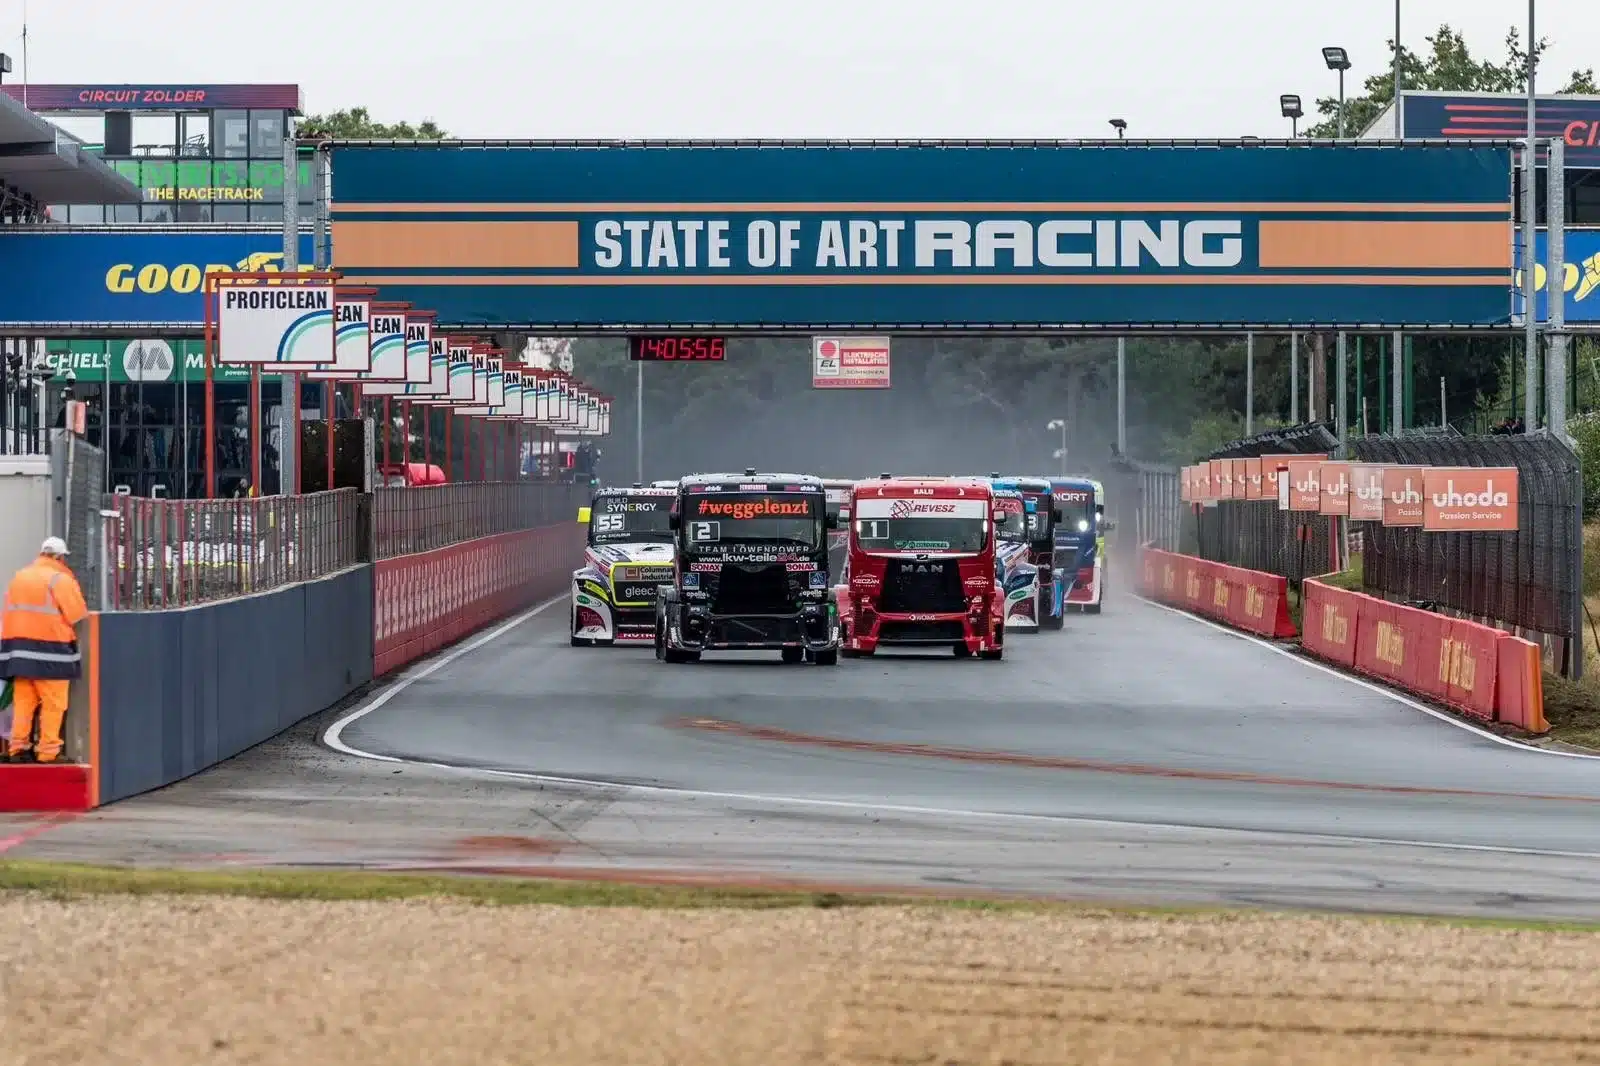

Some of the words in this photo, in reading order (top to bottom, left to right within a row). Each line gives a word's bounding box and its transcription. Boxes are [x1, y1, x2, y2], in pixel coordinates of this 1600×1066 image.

[78, 90, 140, 103] CIRCUIT
[143, 90, 206, 103] ZOLDER
[1563, 120, 1600, 146] CI
[148, 187, 175, 200] THE
[180, 187, 264, 200] RACETRACK
[594, 219, 731, 268] STATE
[747, 219, 801, 268] OF
[815, 219, 905, 268] ART
[914, 219, 1243, 268] RACING
[225, 289, 329, 310] PROFICLEAN
[640, 338, 723, 359] 14:05:56
[820, 359, 837, 368] EL
[1432, 479, 1508, 508] uhoda
[606, 502, 657, 513] SYNERGY
[607, 497, 628, 505] BUILD
[698, 497, 809, 519] #weggelenzt
[913, 504, 956, 513] REVESZ
[1439, 511, 1470, 520] Passion
[1472, 511, 1502, 520] Service
[598, 514, 624, 531] 55
[697, 521, 711, 540] 2
[870, 521, 878, 538] 1
[698, 553, 810, 563] www.lkw-teile24.de
[691, 563, 720, 571] SONAX
[786, 563, 815, 571] SONAX
[901, 564, 944, 573] MAN
